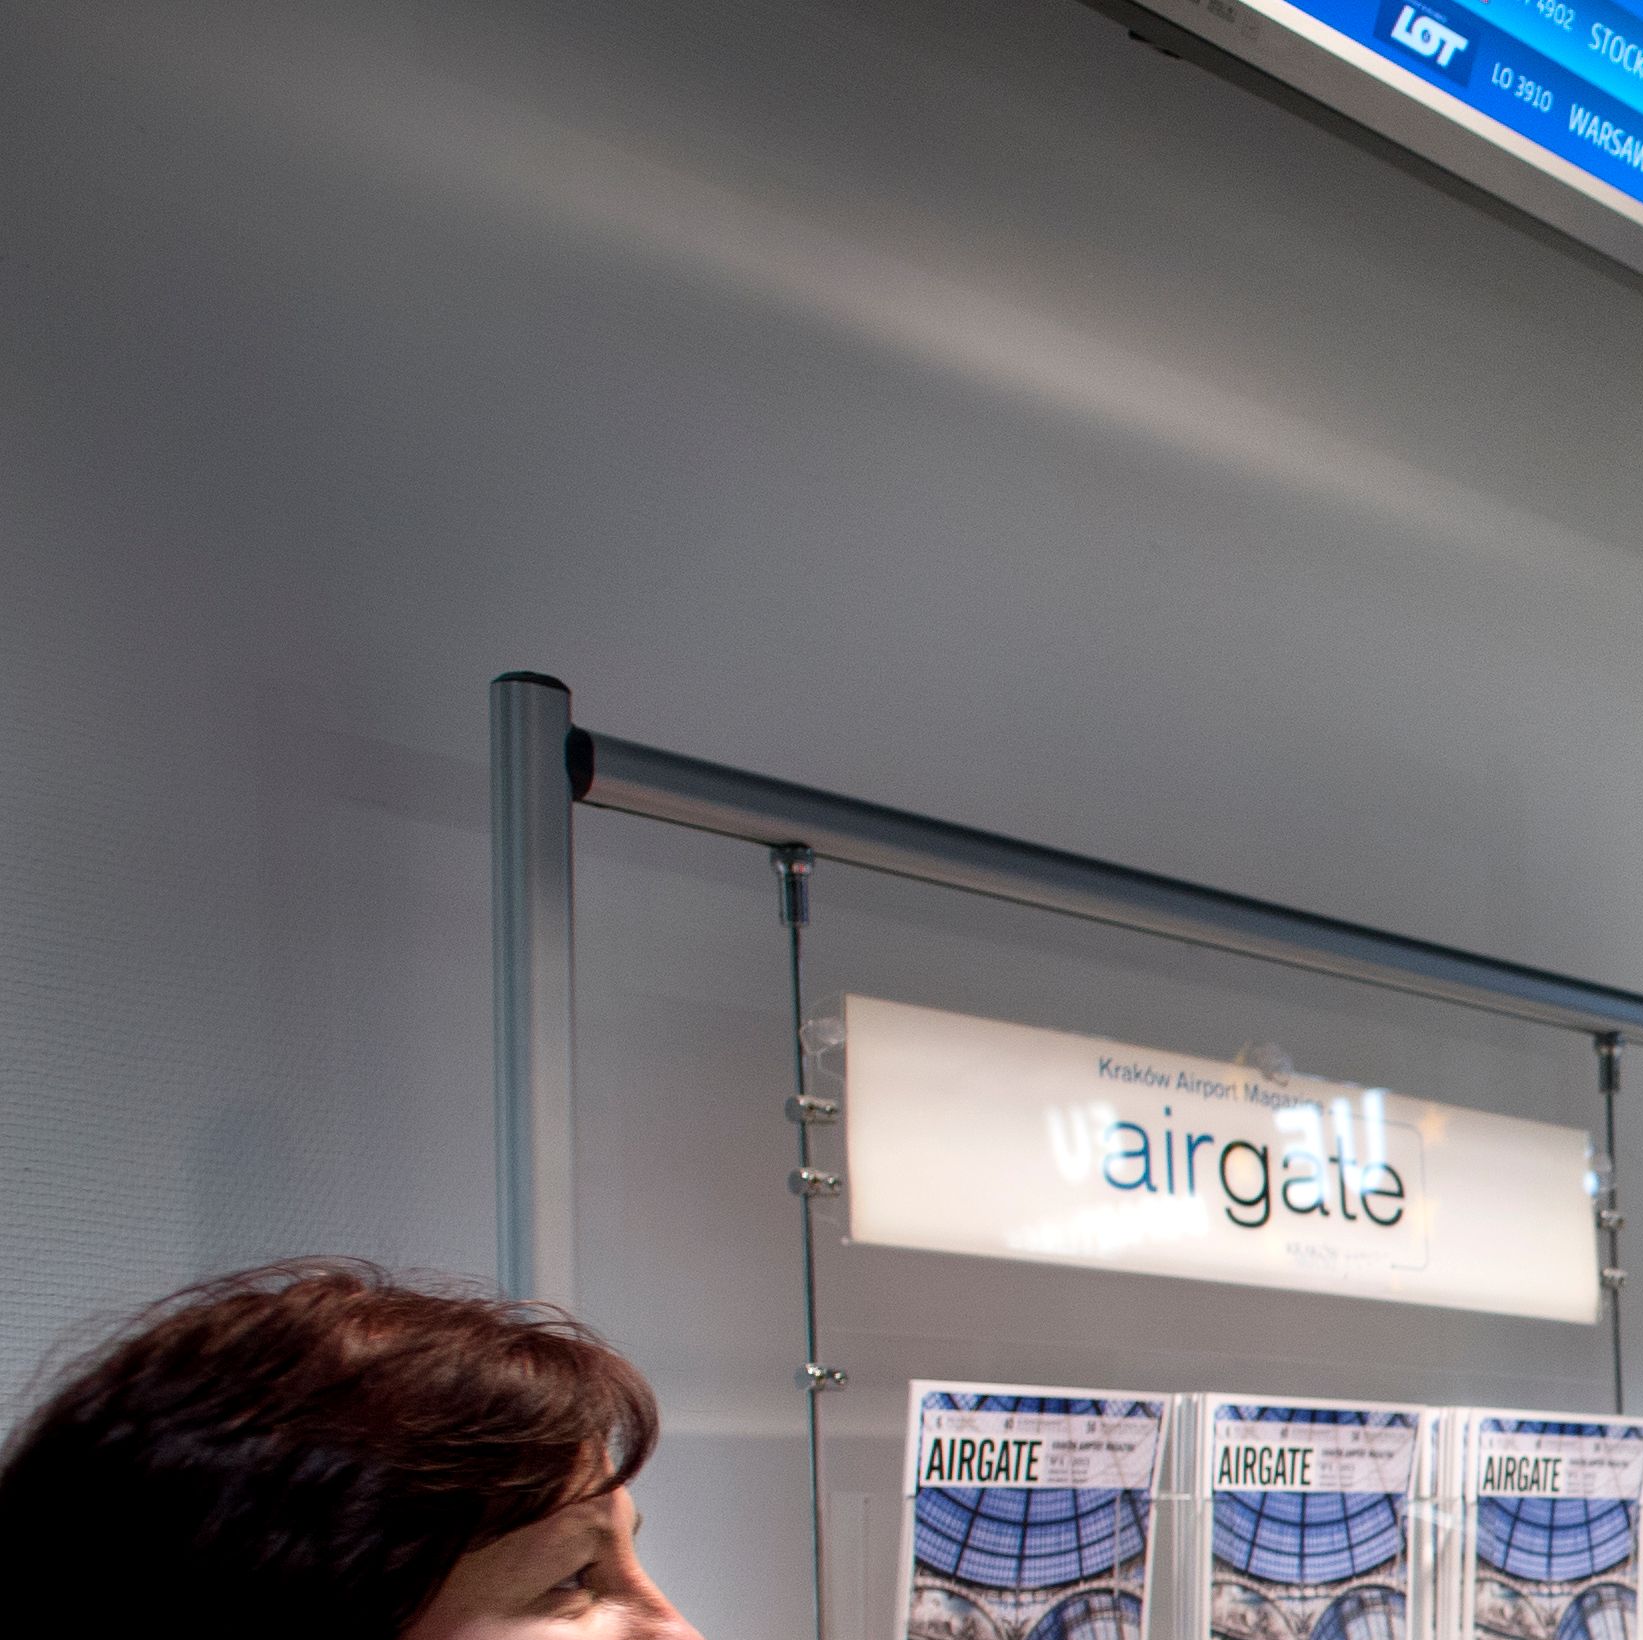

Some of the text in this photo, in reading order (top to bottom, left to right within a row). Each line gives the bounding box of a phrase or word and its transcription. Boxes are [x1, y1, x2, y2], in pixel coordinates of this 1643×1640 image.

[1390, 4, 1469, 68] LOT
[1491, 61, 1514, 89] LO
[1514, 75, 1554, 113] 3910
[1099, 1056, 1169, 1089] Kraków
[1175, 1071, 1240, 1102] Airport
[1102, 1104, 1406, 1229] airgate
[926, 1438, 1042, 1483] AIRGATE
[1219, 1446, 1313, 1486] AIRGATE
[1483, 1456, 1563, 1493] AIRGATE
